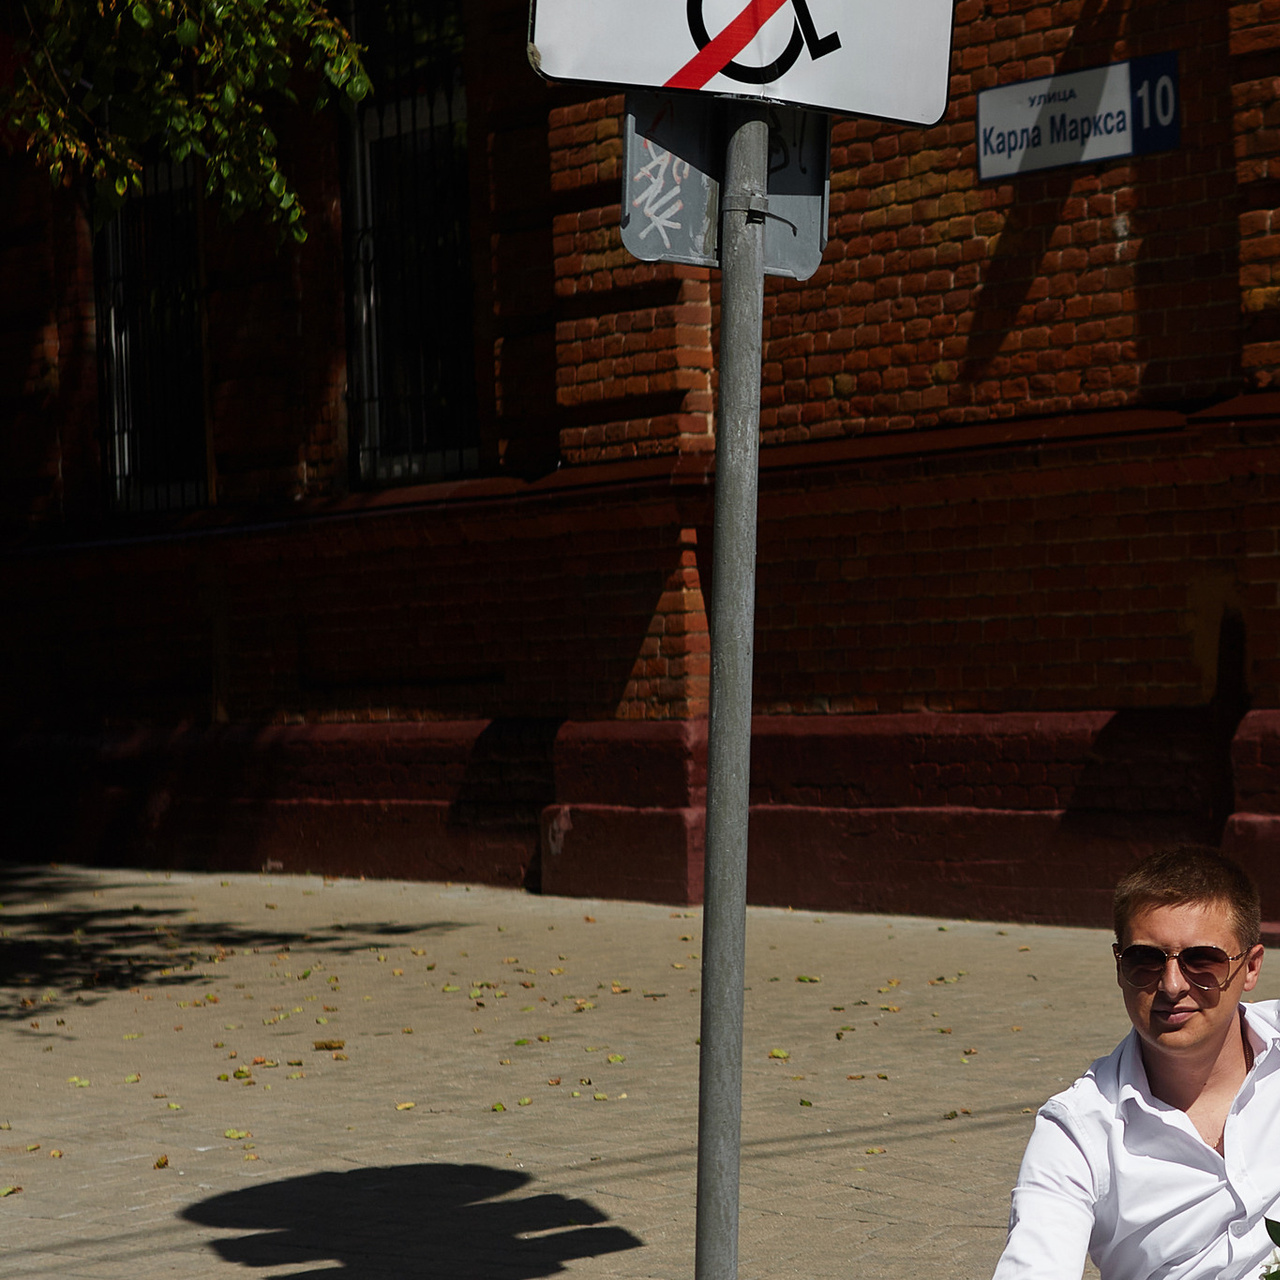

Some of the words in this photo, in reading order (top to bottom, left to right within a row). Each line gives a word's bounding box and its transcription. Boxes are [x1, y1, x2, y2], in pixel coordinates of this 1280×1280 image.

[1137, 74, 1176, 129] 10
[983, 126, 1041, 158] Карла
[1050, 110, 1127, 146] Маркса
